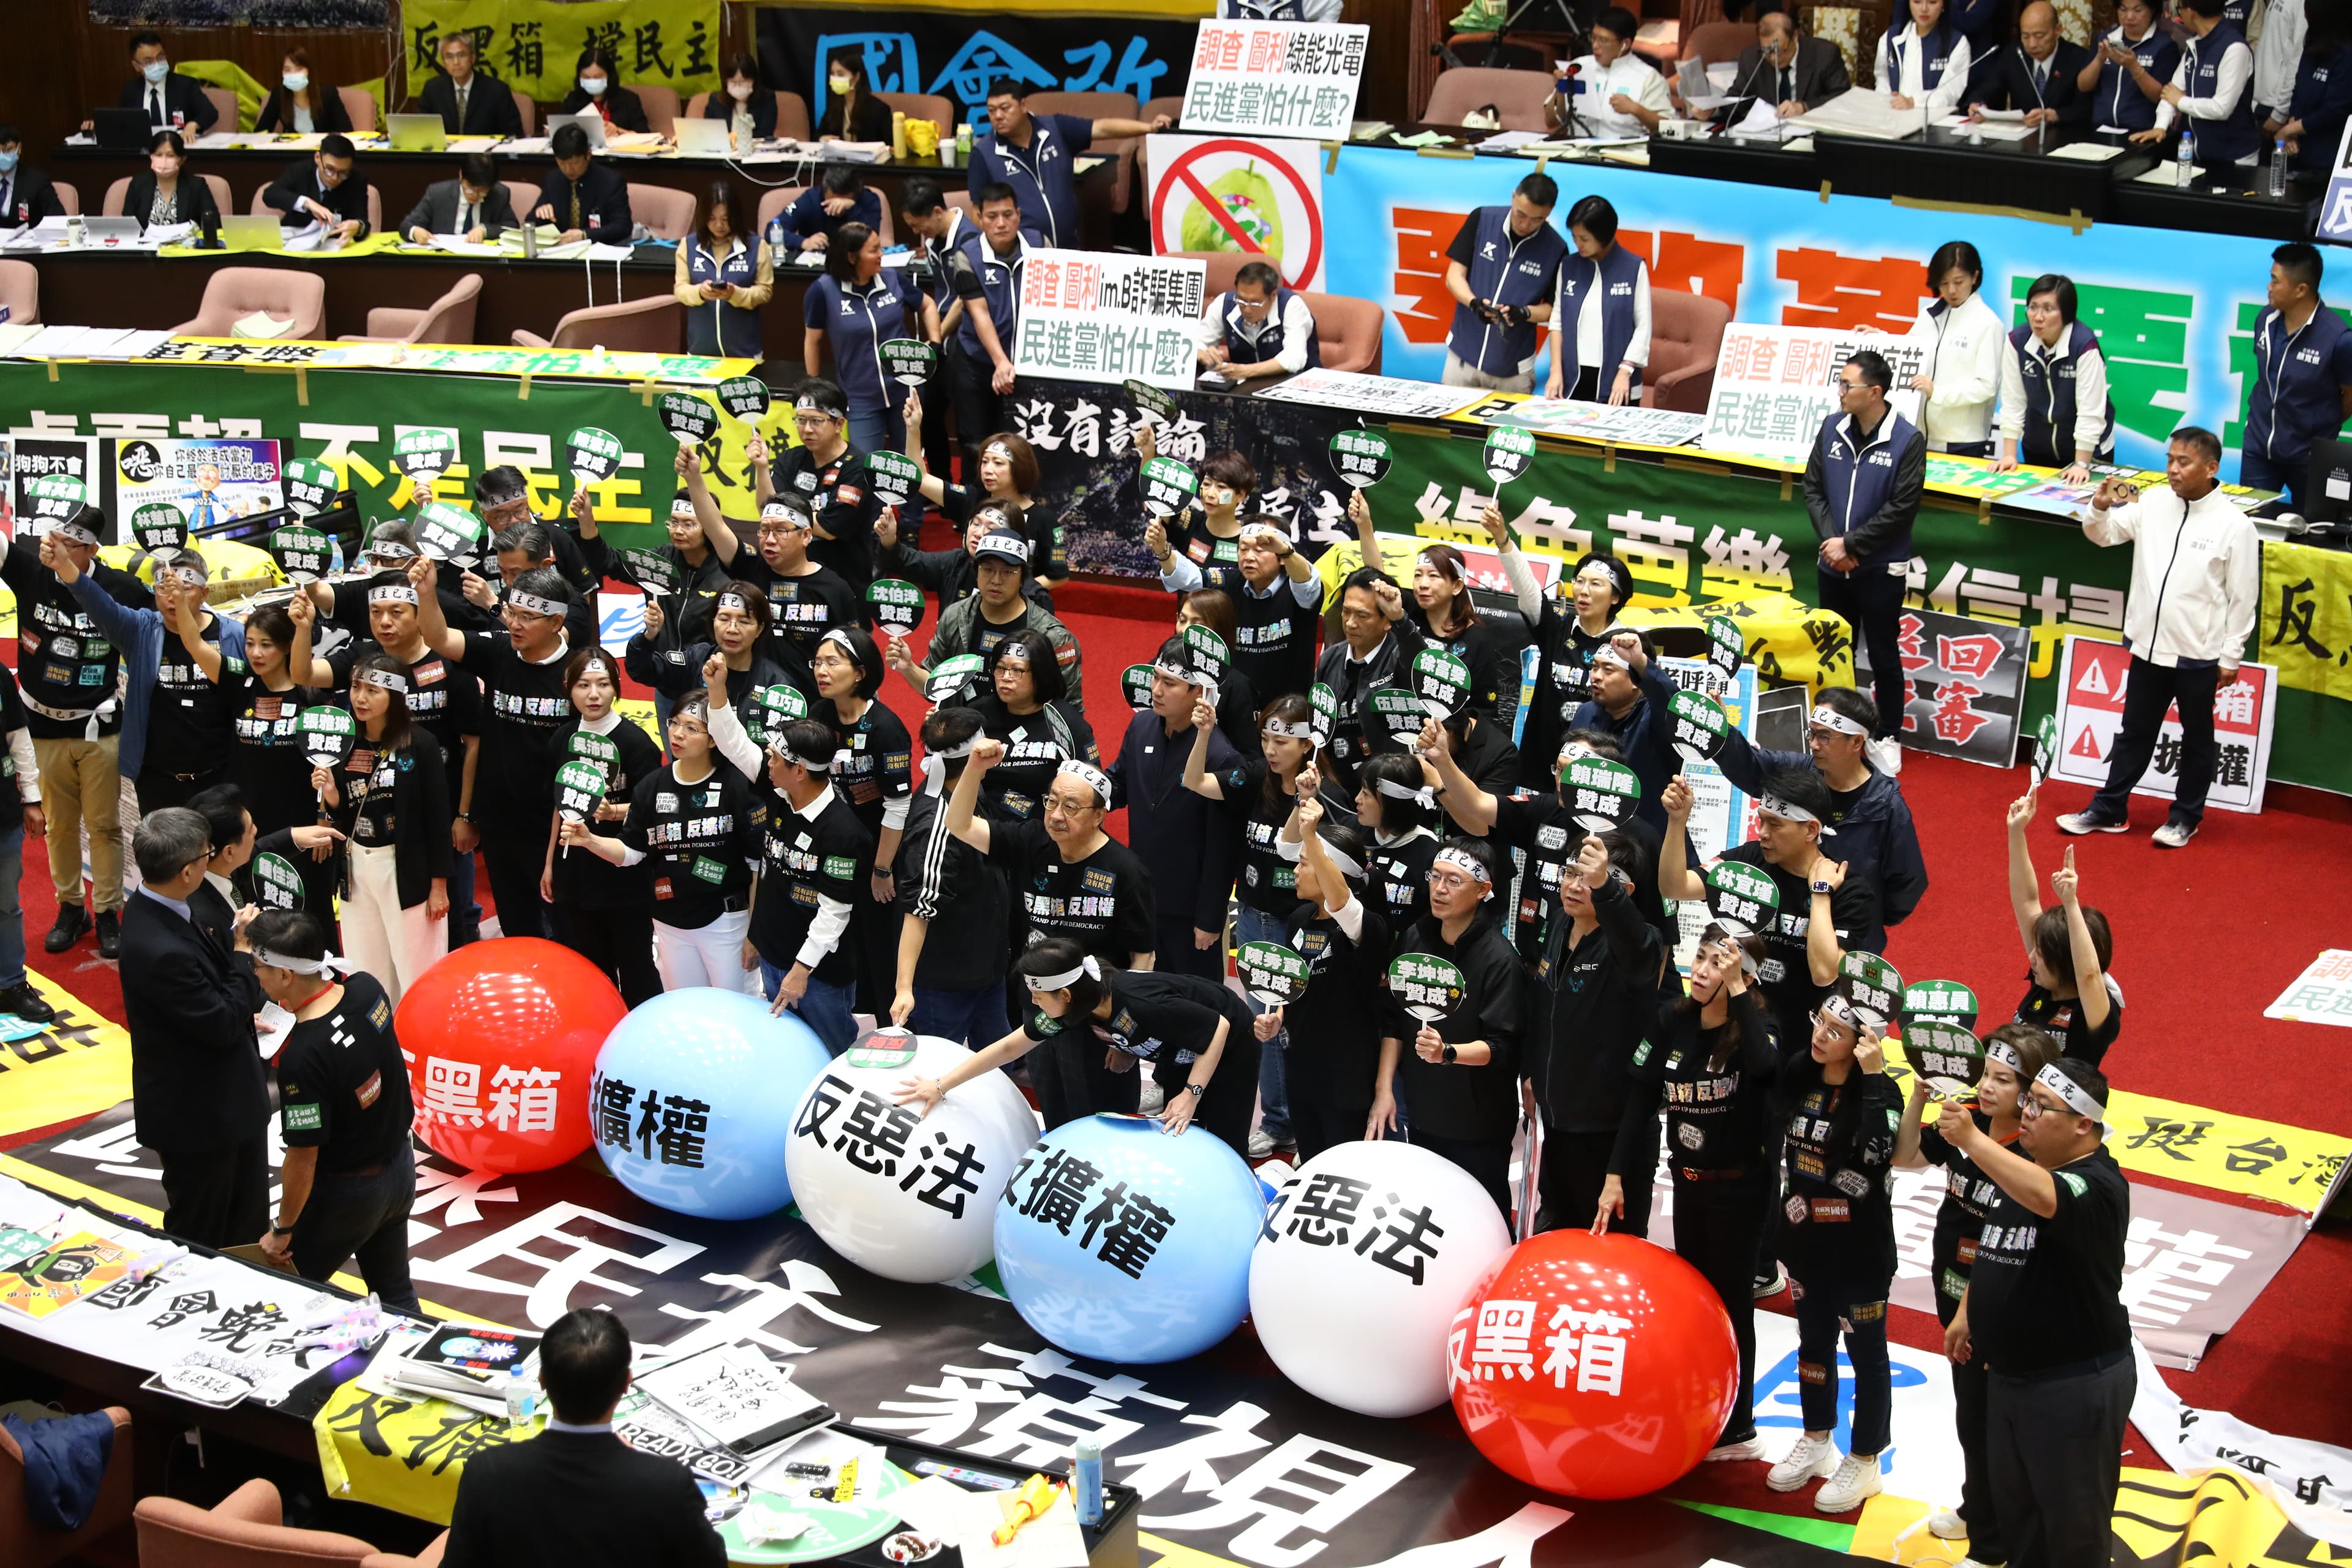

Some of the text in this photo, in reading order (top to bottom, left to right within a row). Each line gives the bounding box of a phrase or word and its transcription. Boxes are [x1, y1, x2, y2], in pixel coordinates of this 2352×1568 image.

[1196, 29, 1365, 77] 調查 圖利綠能光電
[1186, 81, 1350, 128] 民進黨怕什麼?
[1025, 258, 1061, 308] 調查
[1020, 318, 1193, 377] 民進黨怕什麼?
[1720, 334, 1779, 381] 調查
[892, 359, 926, 374] 贊成
[730, 395, 763, 413] 贊成
[671, 412, 705, 434] 贊成
[407, 452, 443, 469] 贊成
[573, 450, 606, 474] 贊成
[869, 454, 918, 478] 陳培瑜
[1341, 454, 1377, 474] 贊成
[1492, 448, 1520, 470] 贊成
[875, 473, 909, 494] 贊成
[1147, 462, 1193, 491] 王世堅
[290, 480, 325, 502] 贊成
[1147, 480, 1183, 504] 贊成
[36, 498, 71, 518] 贊成
[145, 528, 179, 546] 贊成
[276, 532, 326, 551] 陳俊宇
[421, 523, 461, 551] 贊成
[284, 552, 320, 570] 贊成
[635, 565, 669, 586] 贊成
[873, 584, 919, 605] 沈伯洋
[878, 603, 913, 624] 贊成
[1187, 628, 1227, 662] 郭昱晴
[1191, 652, 1221, 679] 贊成
[1709, 645, 1734, 671] 贊成
[930, 673, 964, 691] 贊成
[1420, 678, 1455, 706] 贊成
[303, 712, 351, 733] 張雅琳
[1311, 710, 1330, 735] 贊成
[1385, 714, 1422, 731] 贊成
[1674, 695, 1724, 733] 李柏毅
[307, 733, 342, 753] 贊成
[1673, 718, 1710, 751] 贊成
[1569, 763, 1634, 794] 賴瑞隆
[562, 787, 592, 811] 贊成
[1575, 790, 1620, 818] 贊成
[1085, 878, 1112, 892] 沒有民主
[1087, 870, 1113, 883] 沒有討論
[1716, 866, 1774, 905] 林宜瑾
[263, 880, 294, 909] 贊成
[1717, 893, 1761, 924] 贊成
[1068, 921, 1106, 930] DEMOCRACY
[1249, 967, 1291, 994] 贊成
[1396, 960, 1457, 986] 李坤城
[1405, 981, 1448, 1006] 贊成
[1851, 987, 1891, 1013] 贊成
[1905, 989, 1970, 1012] 賴惠員
[1909, 1027, 1977, 1055] 蔡易餘
[1921, 1050, 1970, 1078] 贊成
[589, 1065, 711, 1169] 擴權
[792, 1073, 986, 1220] 反惡法
[1446, 1298, 1633, 1397] 反黑箱
[695, 1449, 750, 1482] GO!
